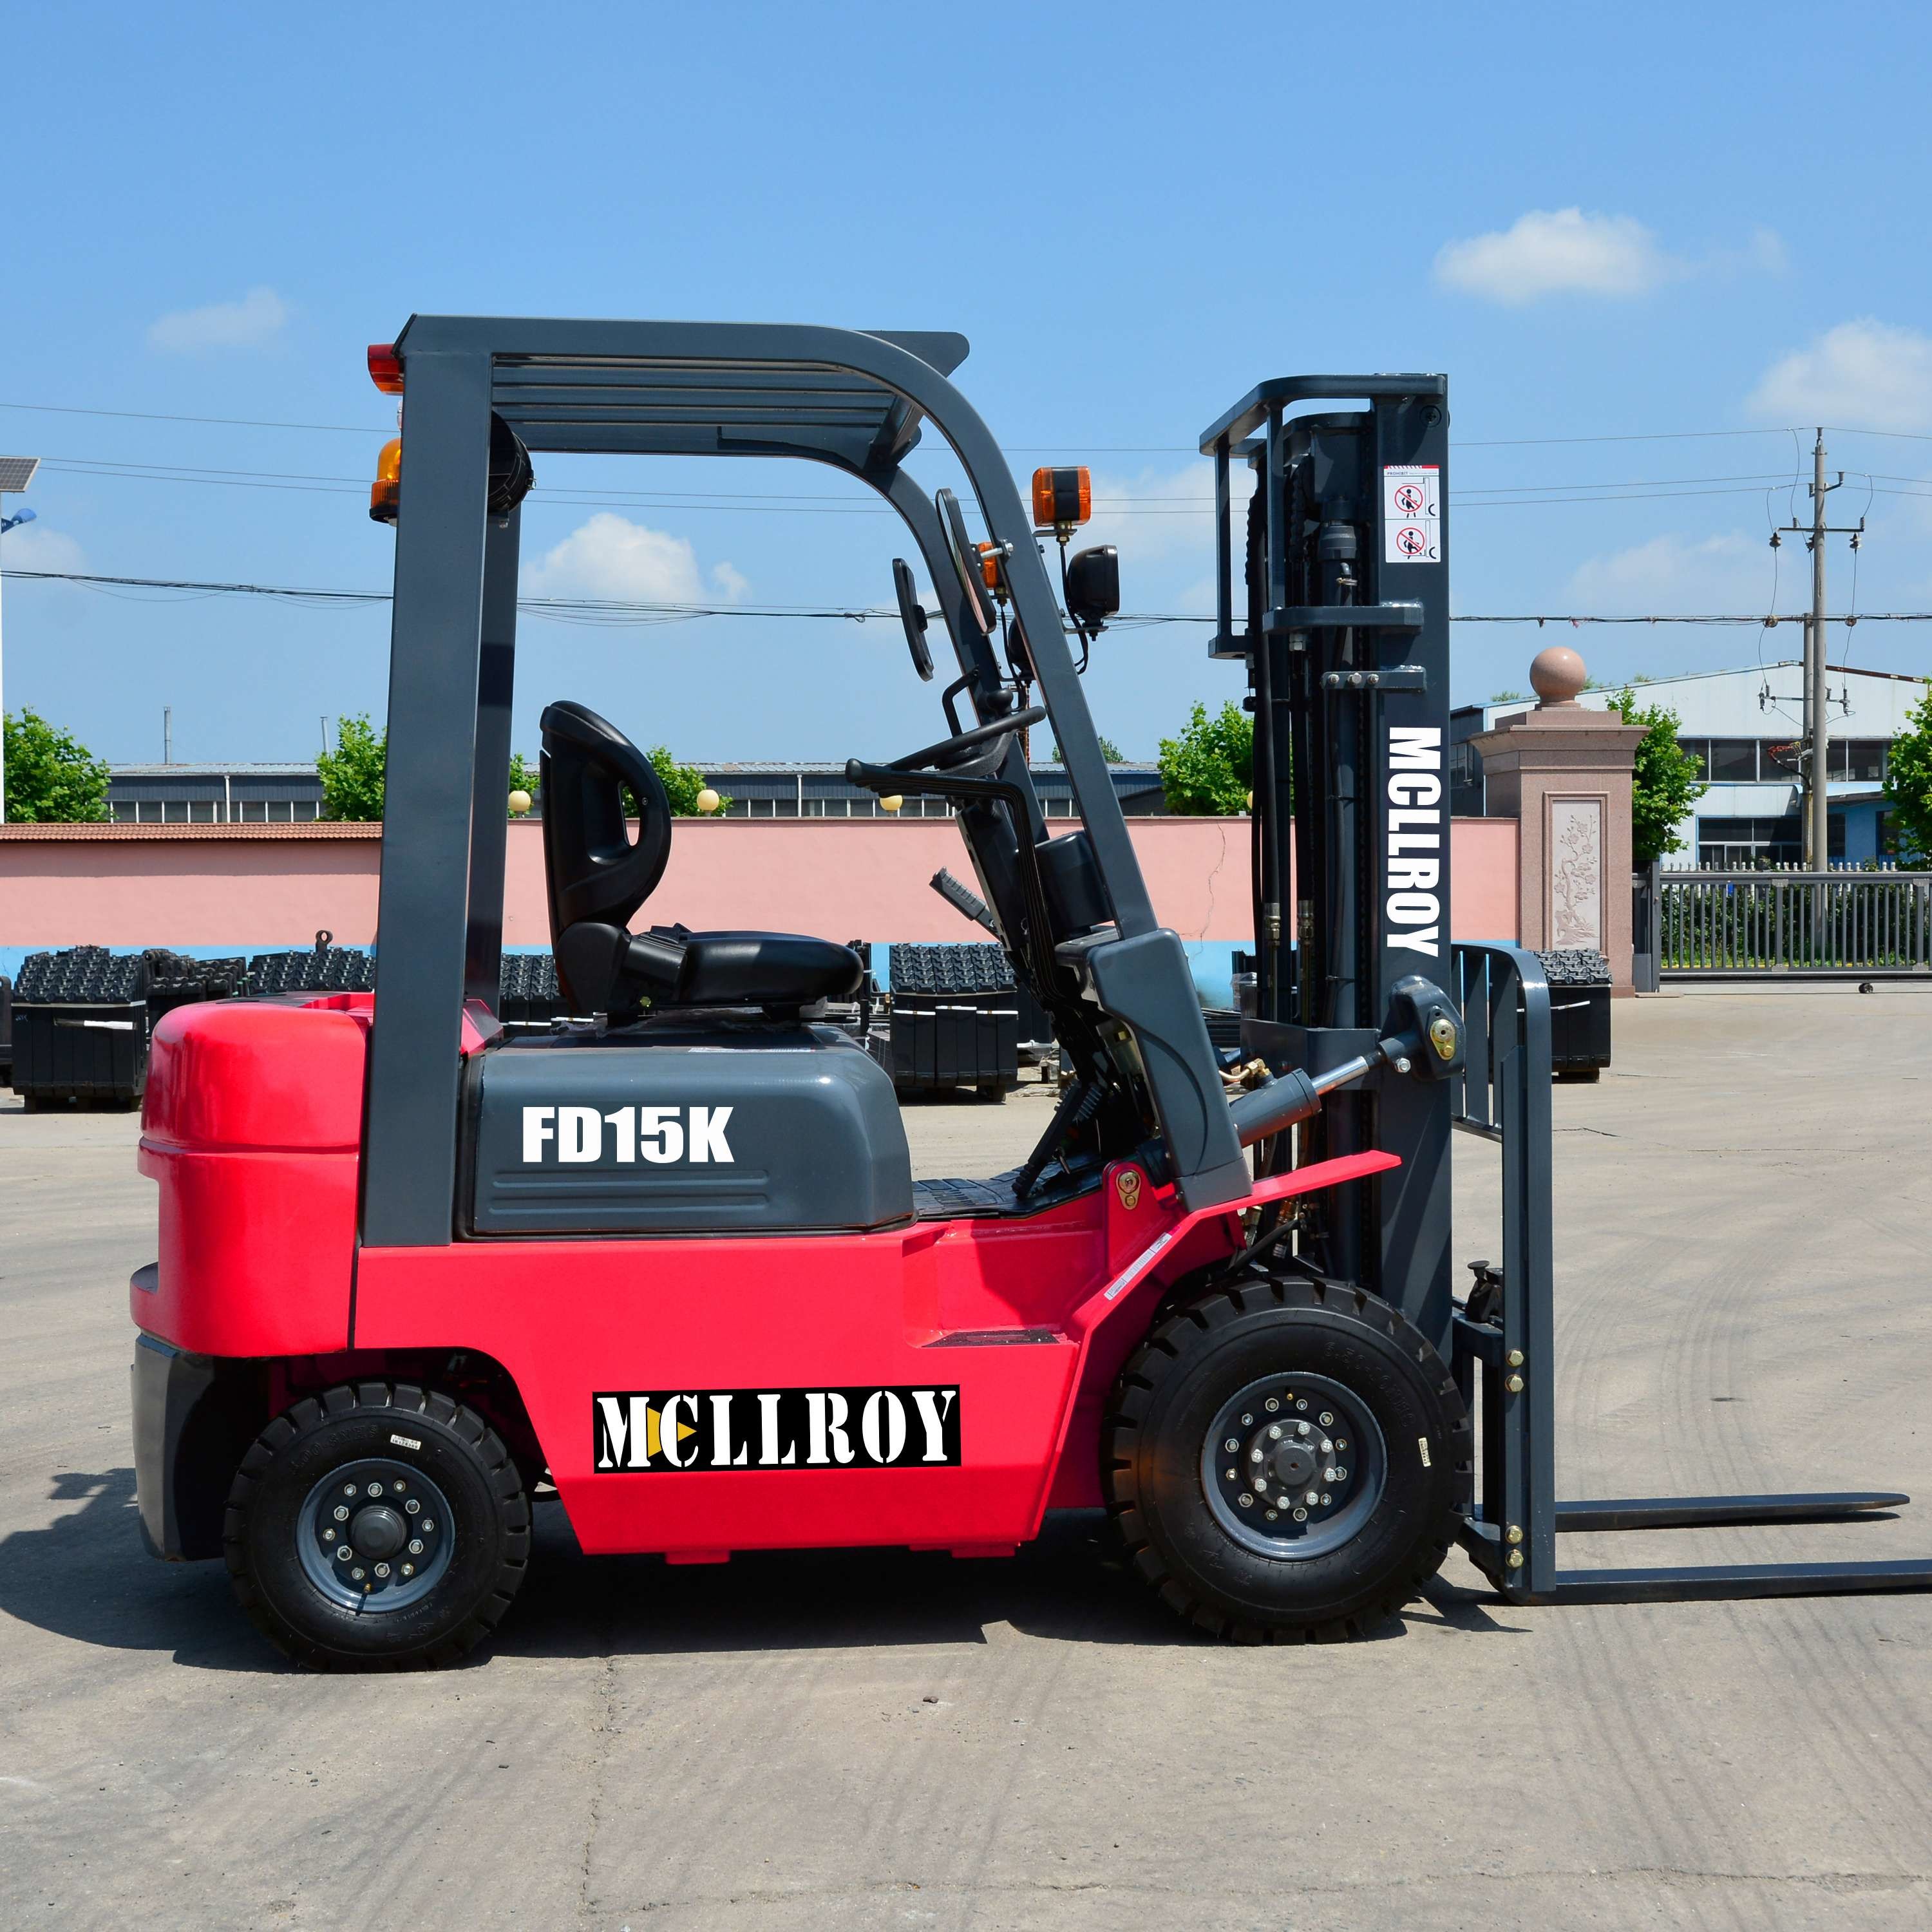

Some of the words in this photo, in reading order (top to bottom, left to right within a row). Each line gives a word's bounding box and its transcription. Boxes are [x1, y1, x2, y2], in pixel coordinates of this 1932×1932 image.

[1387, 727, 1441, 957] MCLLROY
[523, 1106, 735, 1164] FD15K
[597, 1390, 956, 1468] MCLLROY
